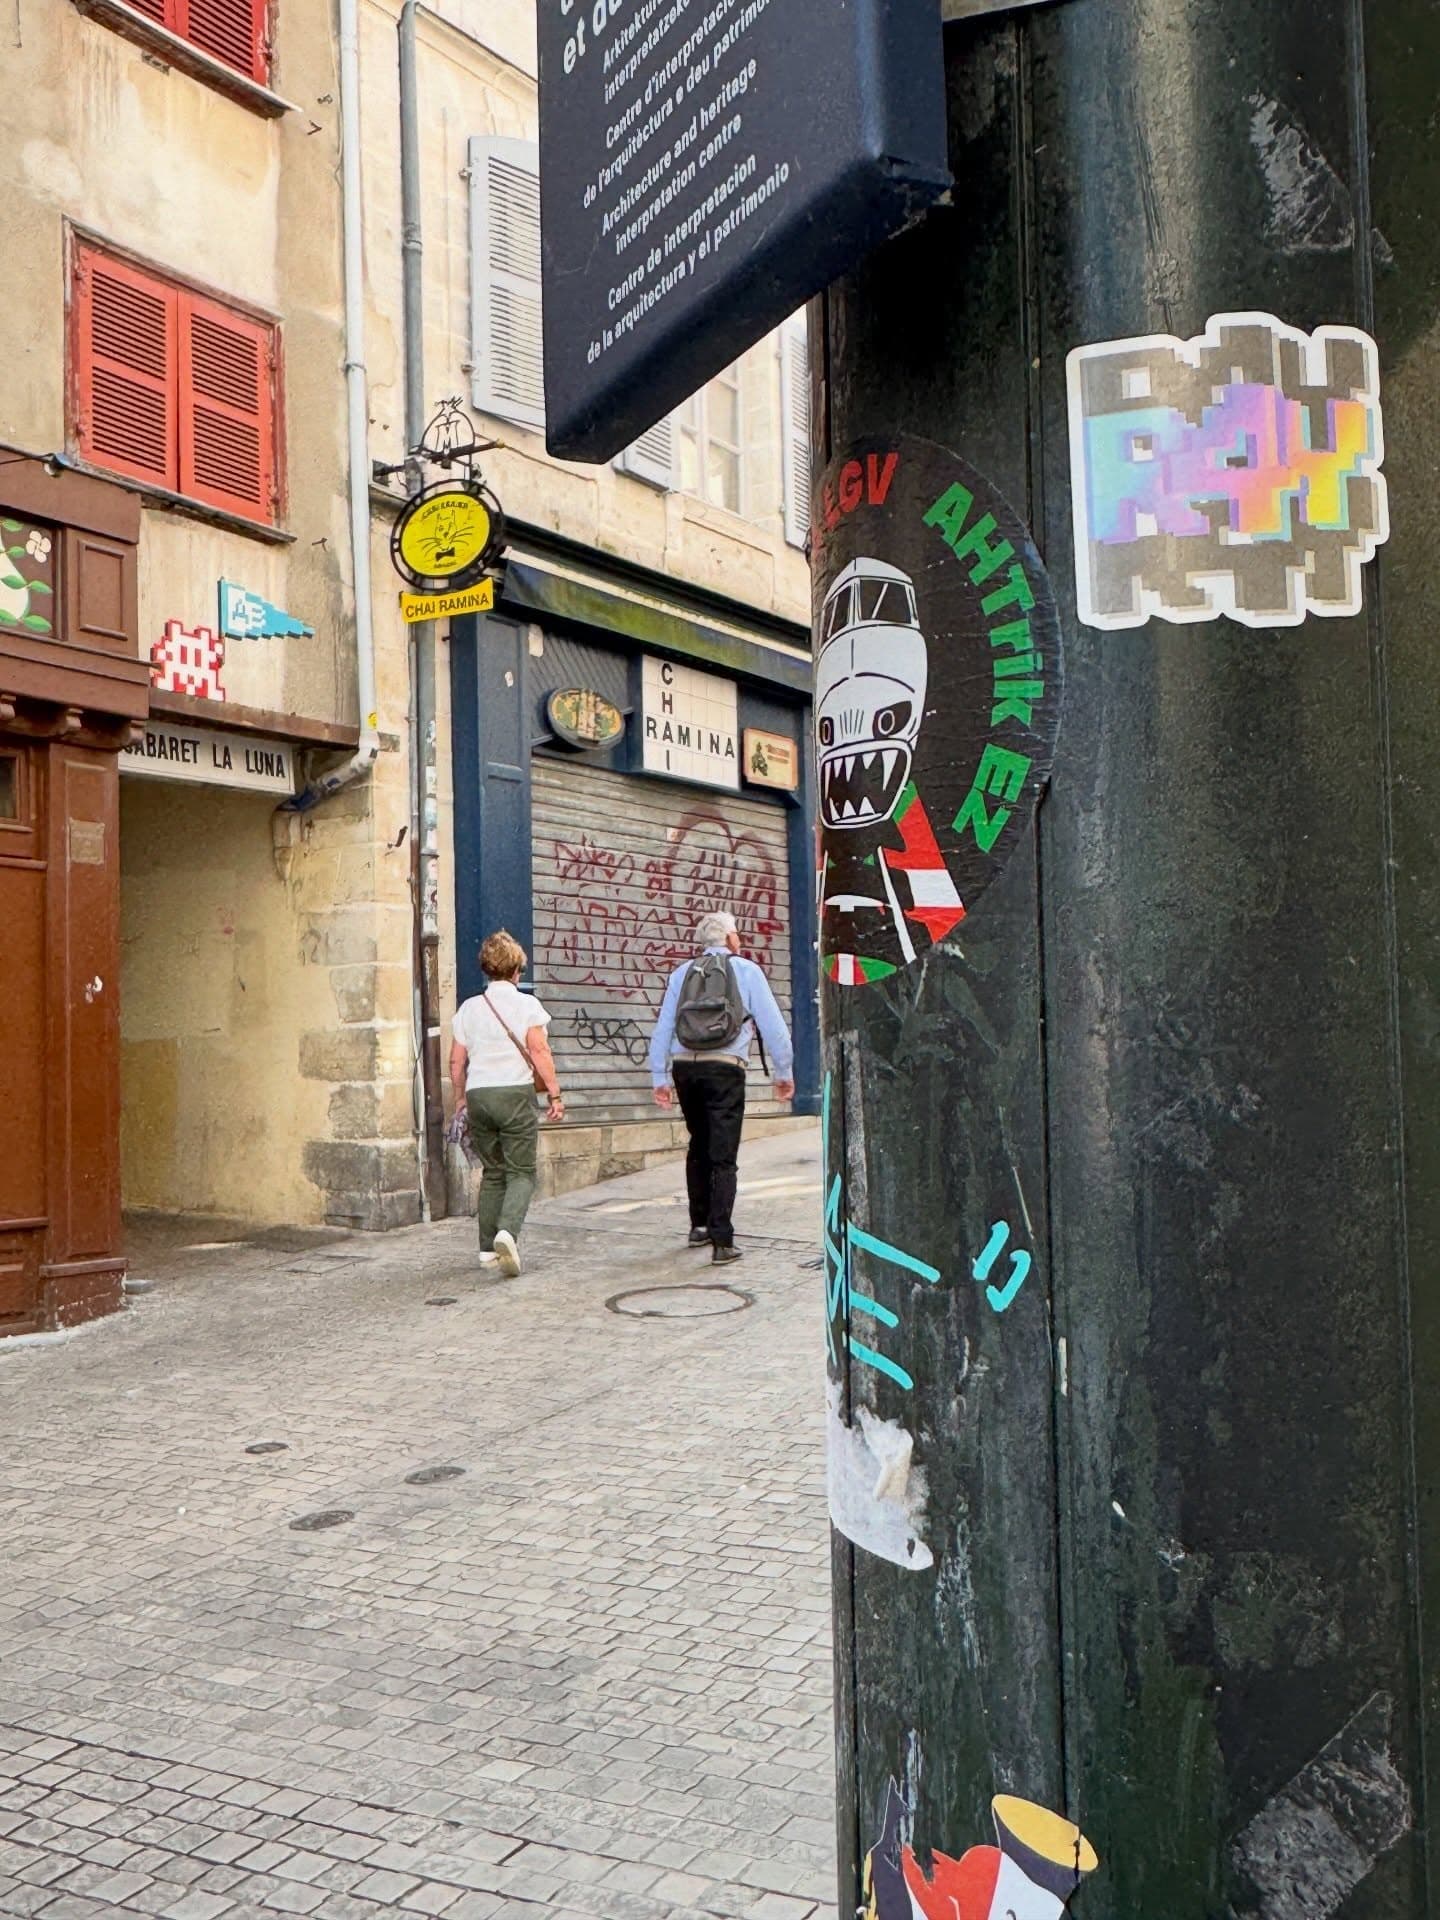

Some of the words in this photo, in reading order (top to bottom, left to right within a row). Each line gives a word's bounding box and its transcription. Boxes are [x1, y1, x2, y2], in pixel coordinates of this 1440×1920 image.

[563, 15, 586, 74] et
[583, 184, 596, 208] de
[686, 56, 710, 93] deu
[713, 0, 769, 69] patrimo
[602, 155, 671, 236] Architecture
[674, 116, 698, 159] and
[700, 57, 757, 130] heritage
[616, 160, 696, 255] interpretation
[699, 113, 742, 169] centre
[587, 341, 600, 364] de
[602, 328, 613, 351] la
[615, 260, 686, 339] arquitectura
[688, 248, 696, 275] y
[699, 233, 711, 260] el
[714, 161, 789, 252] patrimonio
[608, 264, 645, 311] Centro
[647, 248, 662, 273] de
[664, 154, 756, 257] interpretacion
[405, 602, 435, 618] CHAI
[439, 593, 489, 612] RAMINA
[212, 743, 232, 770] LA
[245, 749, 285, 778] LUNA
[646, 716, 735, 759] RAMINA
[952, 742, 1033, 855] EZ
